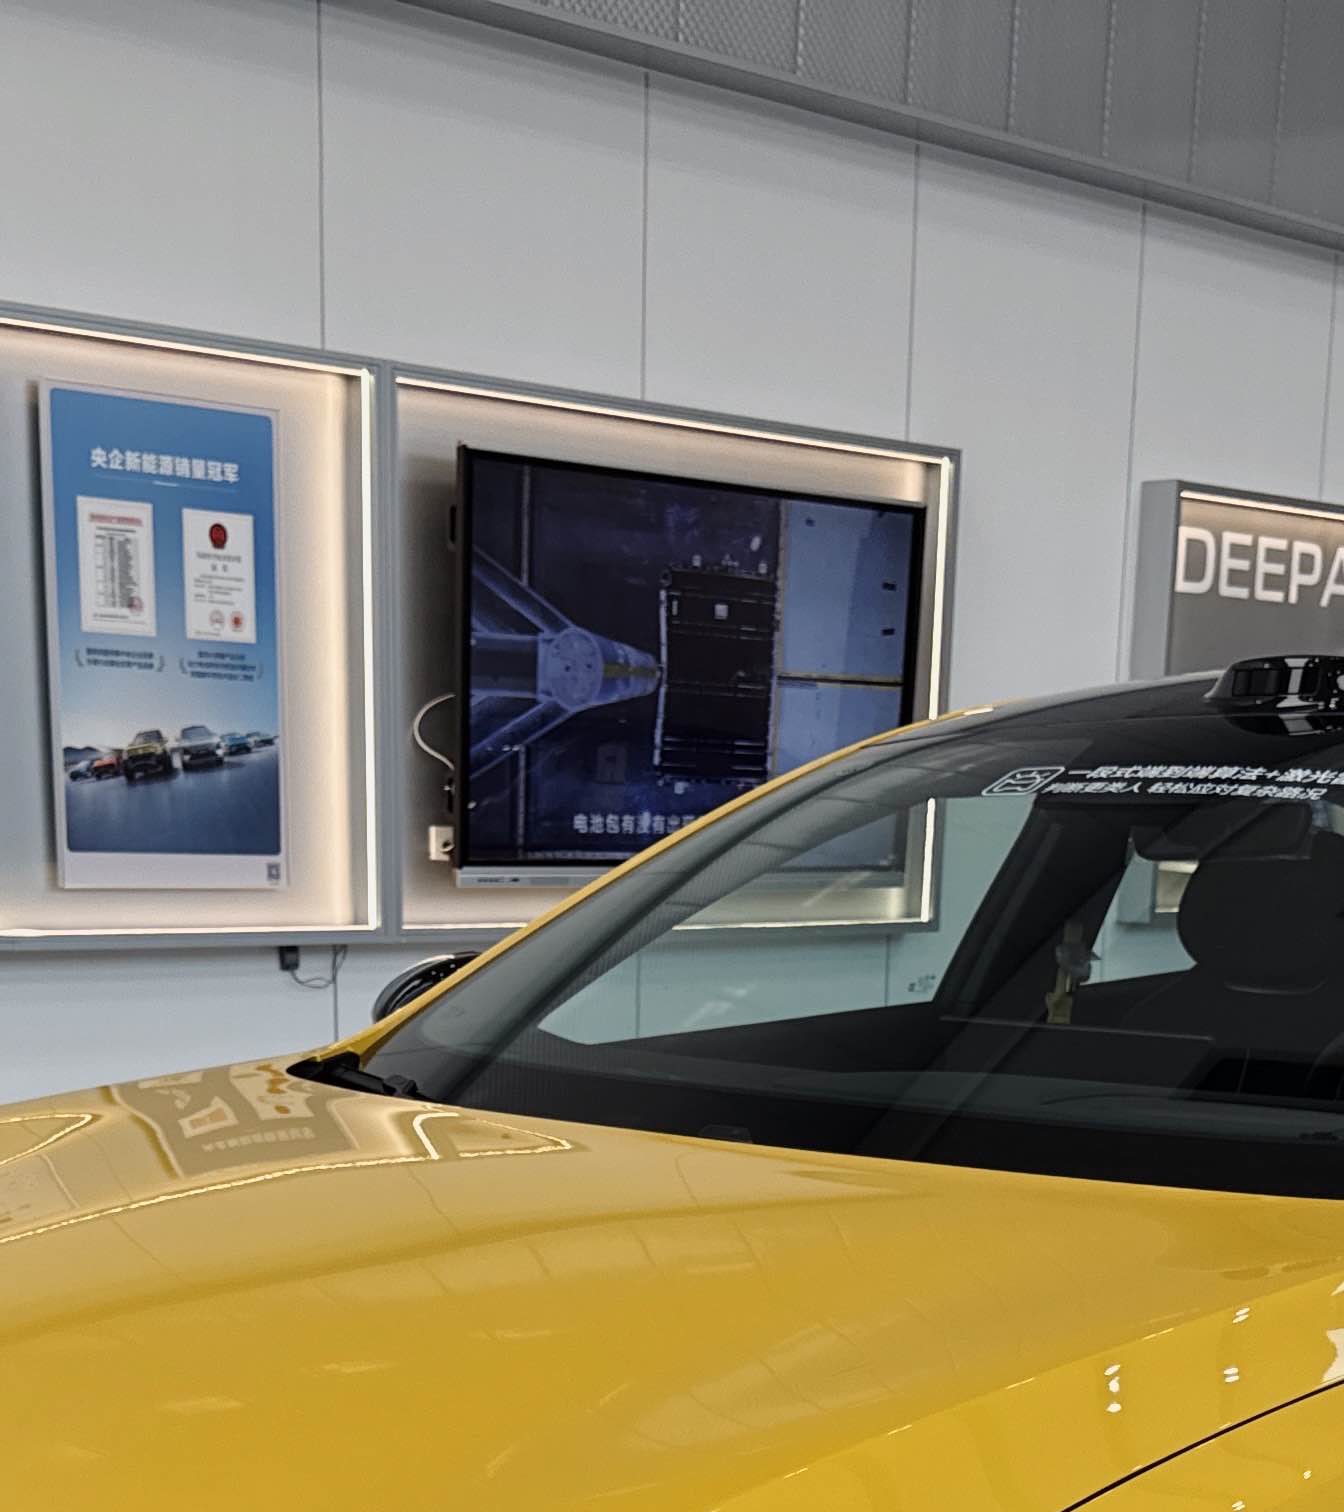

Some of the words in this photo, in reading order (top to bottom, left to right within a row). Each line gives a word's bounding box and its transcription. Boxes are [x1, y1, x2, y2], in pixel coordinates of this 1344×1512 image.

[90, 444, 241, 483] 央企新能源销量冠军
[572, 810, 698, 836] 电池包有没有出
